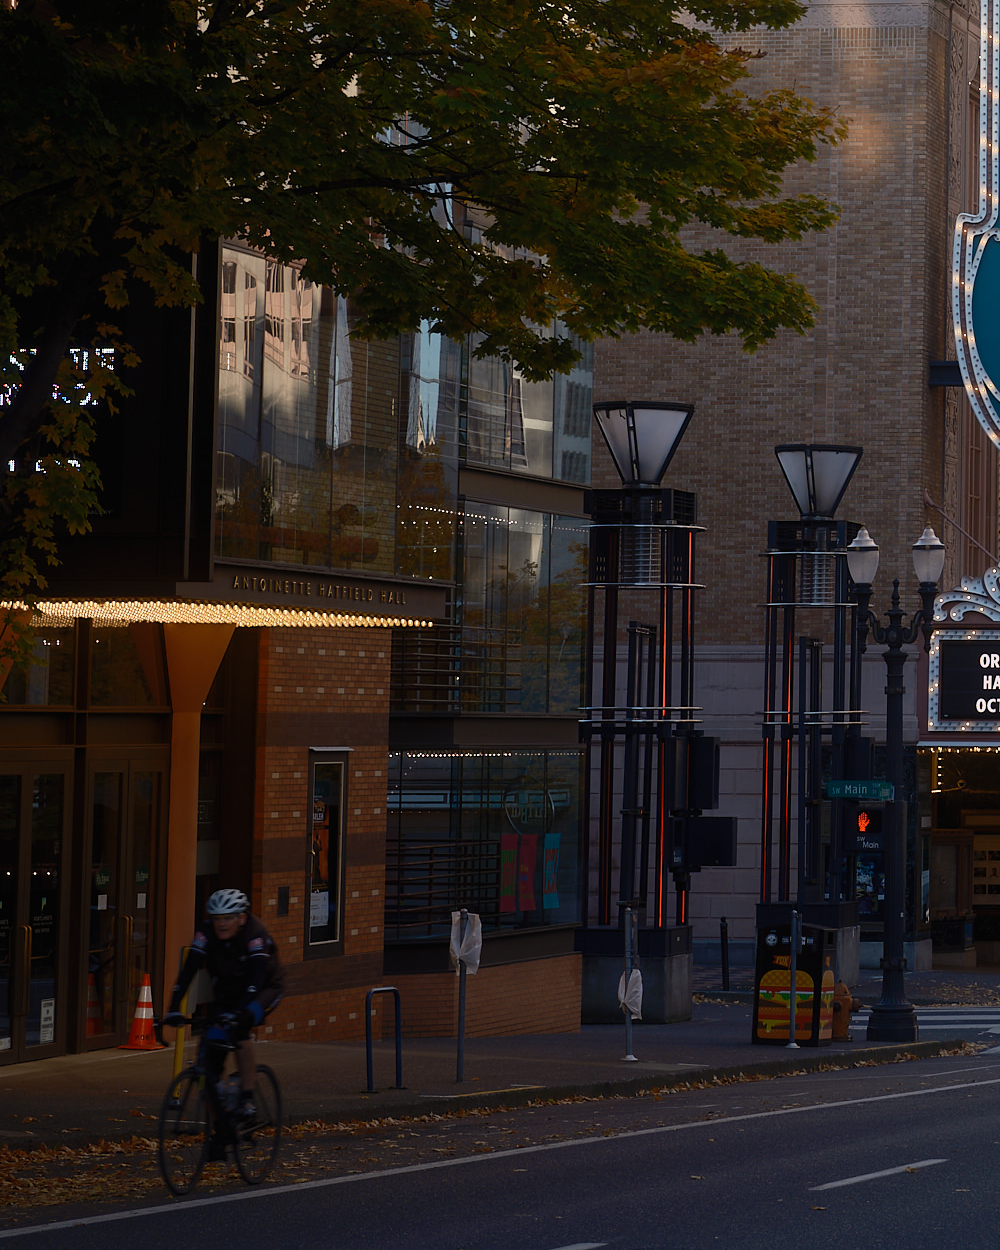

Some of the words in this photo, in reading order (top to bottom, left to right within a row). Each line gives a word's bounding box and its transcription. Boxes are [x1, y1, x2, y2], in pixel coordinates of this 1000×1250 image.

[233, 575, 311, 595] ANTOINETTE
[319, 583, 373, 601] HATFIELD
[381, 591, 406, 605] HALL
[832, 787, 840, 795] SW
[844, 784, 867, 795] Main
[862, 841, 879, 849] Main
